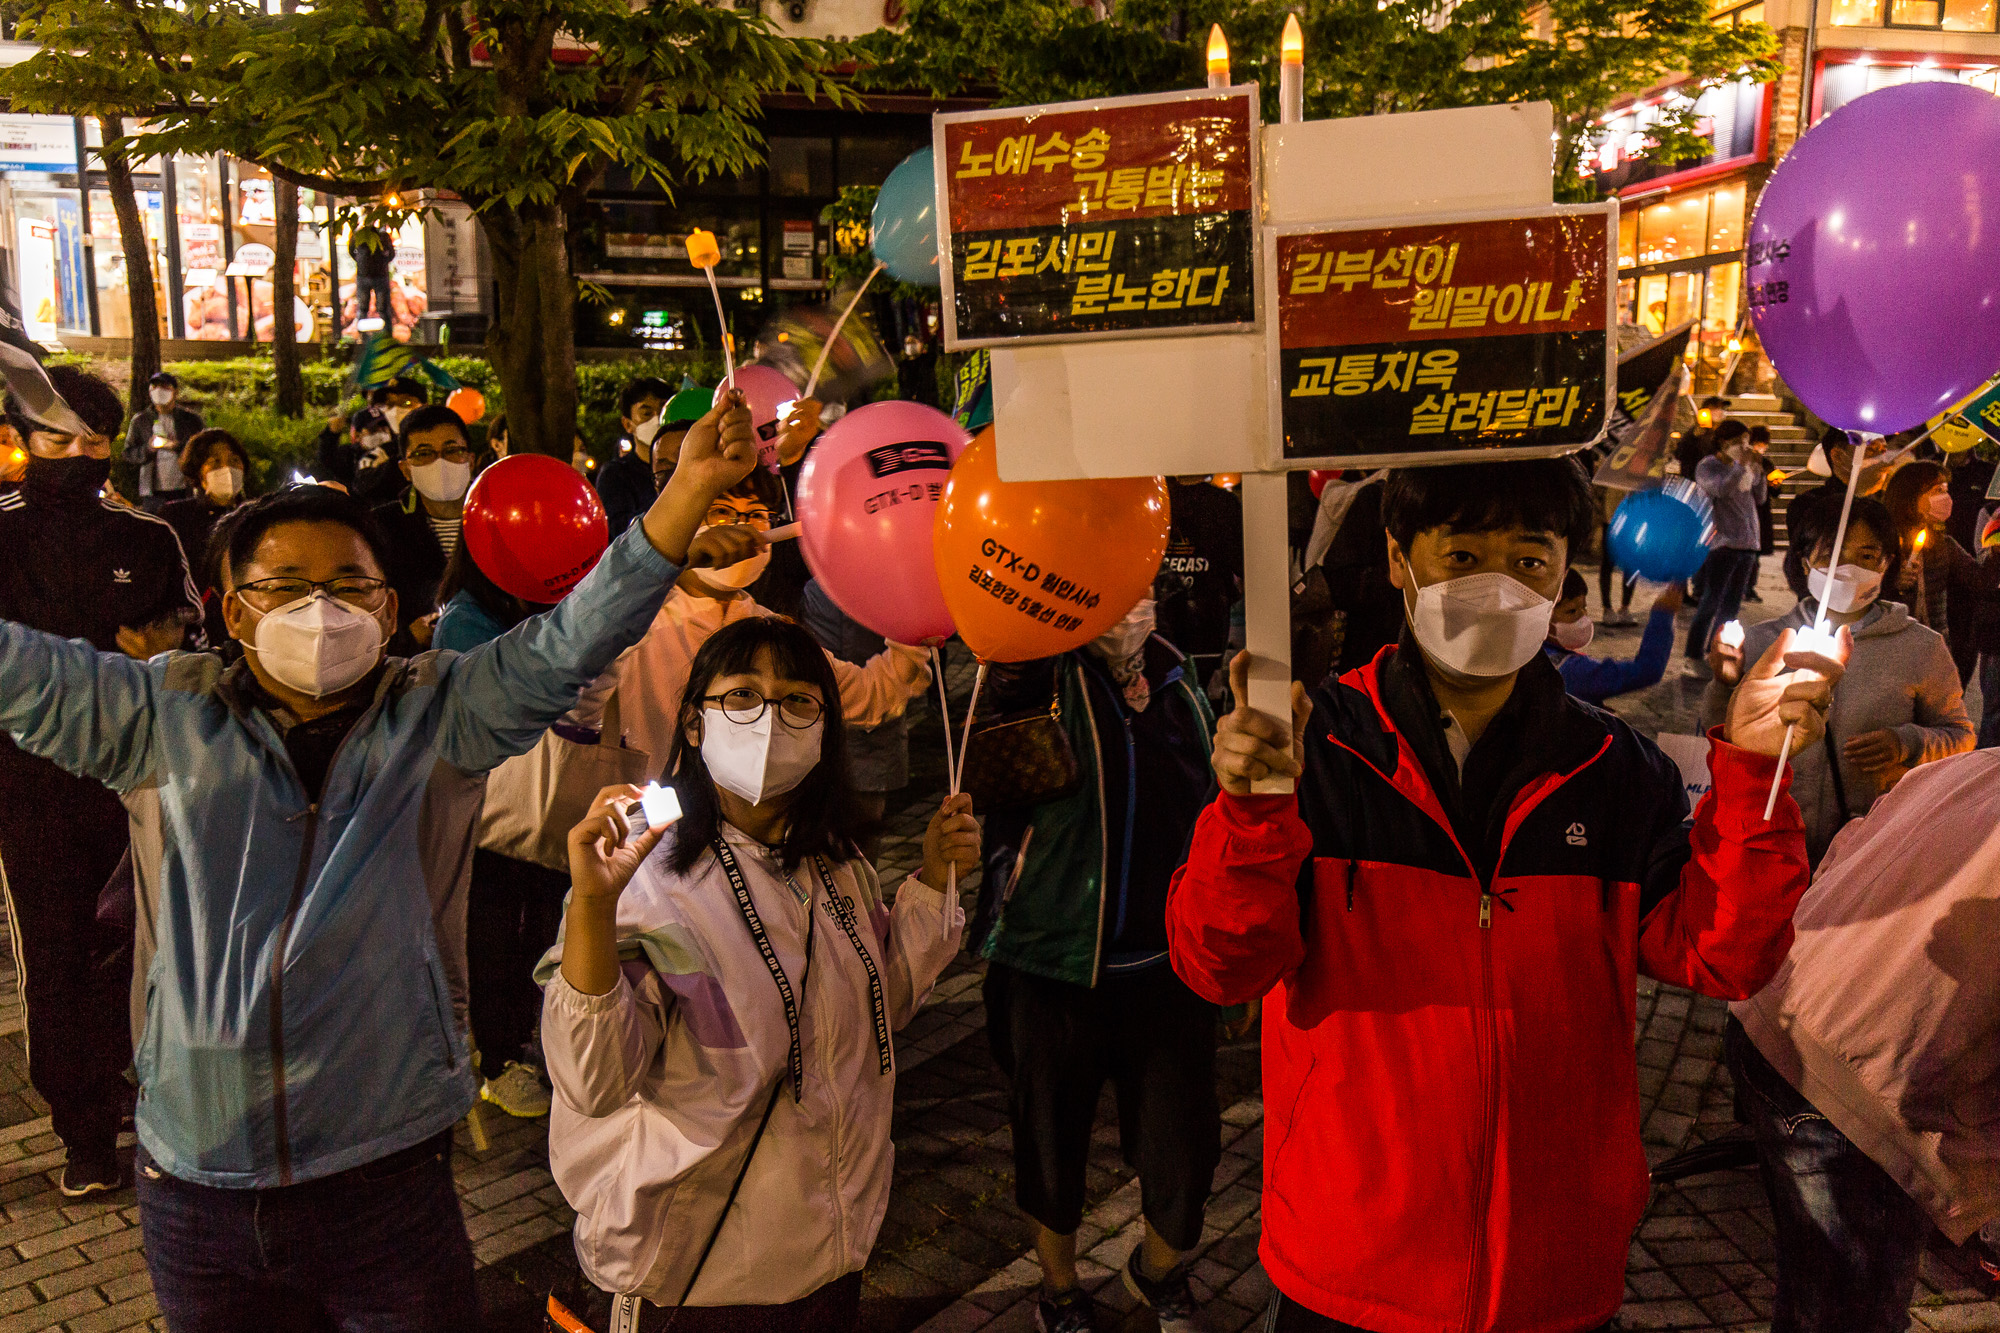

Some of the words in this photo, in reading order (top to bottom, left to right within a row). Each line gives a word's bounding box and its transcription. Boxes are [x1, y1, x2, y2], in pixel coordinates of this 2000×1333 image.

[955, 127, 1111, 179] 노예수송
[1065, 163, 1226, 212] 고통받는
[964, 230, 1116, 281] 김포시민
[1290, 243, 1460, 294] 김부선이
[1071, 265, 1230, 315] 분노한다
[1408, 279, 1584, 330] 웬말이냐
[1290, 349, 1460, 397] 교통지옥
[1409, 386, 1581, 435] 살려달라
[981, 538, 1041, 582] GTX-D
[968, 564, 1020, 605] 김포한강
[729, 869, 743, 889] YES
[823, 873, 833, 887] OR
[737, 889, 749, 904] OR
[829, 886, 845, 915] YEAH!
[743, 903, 763, 934] YEAH!
[843, 916, 855, 936] YES
[758, 936, 772, 957] YES
[851, 935, 864, 950] OR
[767, 957, 780, 972] OR
[858, 948, 877, 977] YEAH!
[773, 970, 793, 1002] YEAH!
[870, 978, 882, 999] YES
[786, 1004, 798, 1026] YES
[874, 999, 883, 1015] OR
[875, 1013, 888, 1044] YEAH!
[792, 1042, 801, 1075] YEAH!
[881, 1046, 890, 1066] YES
